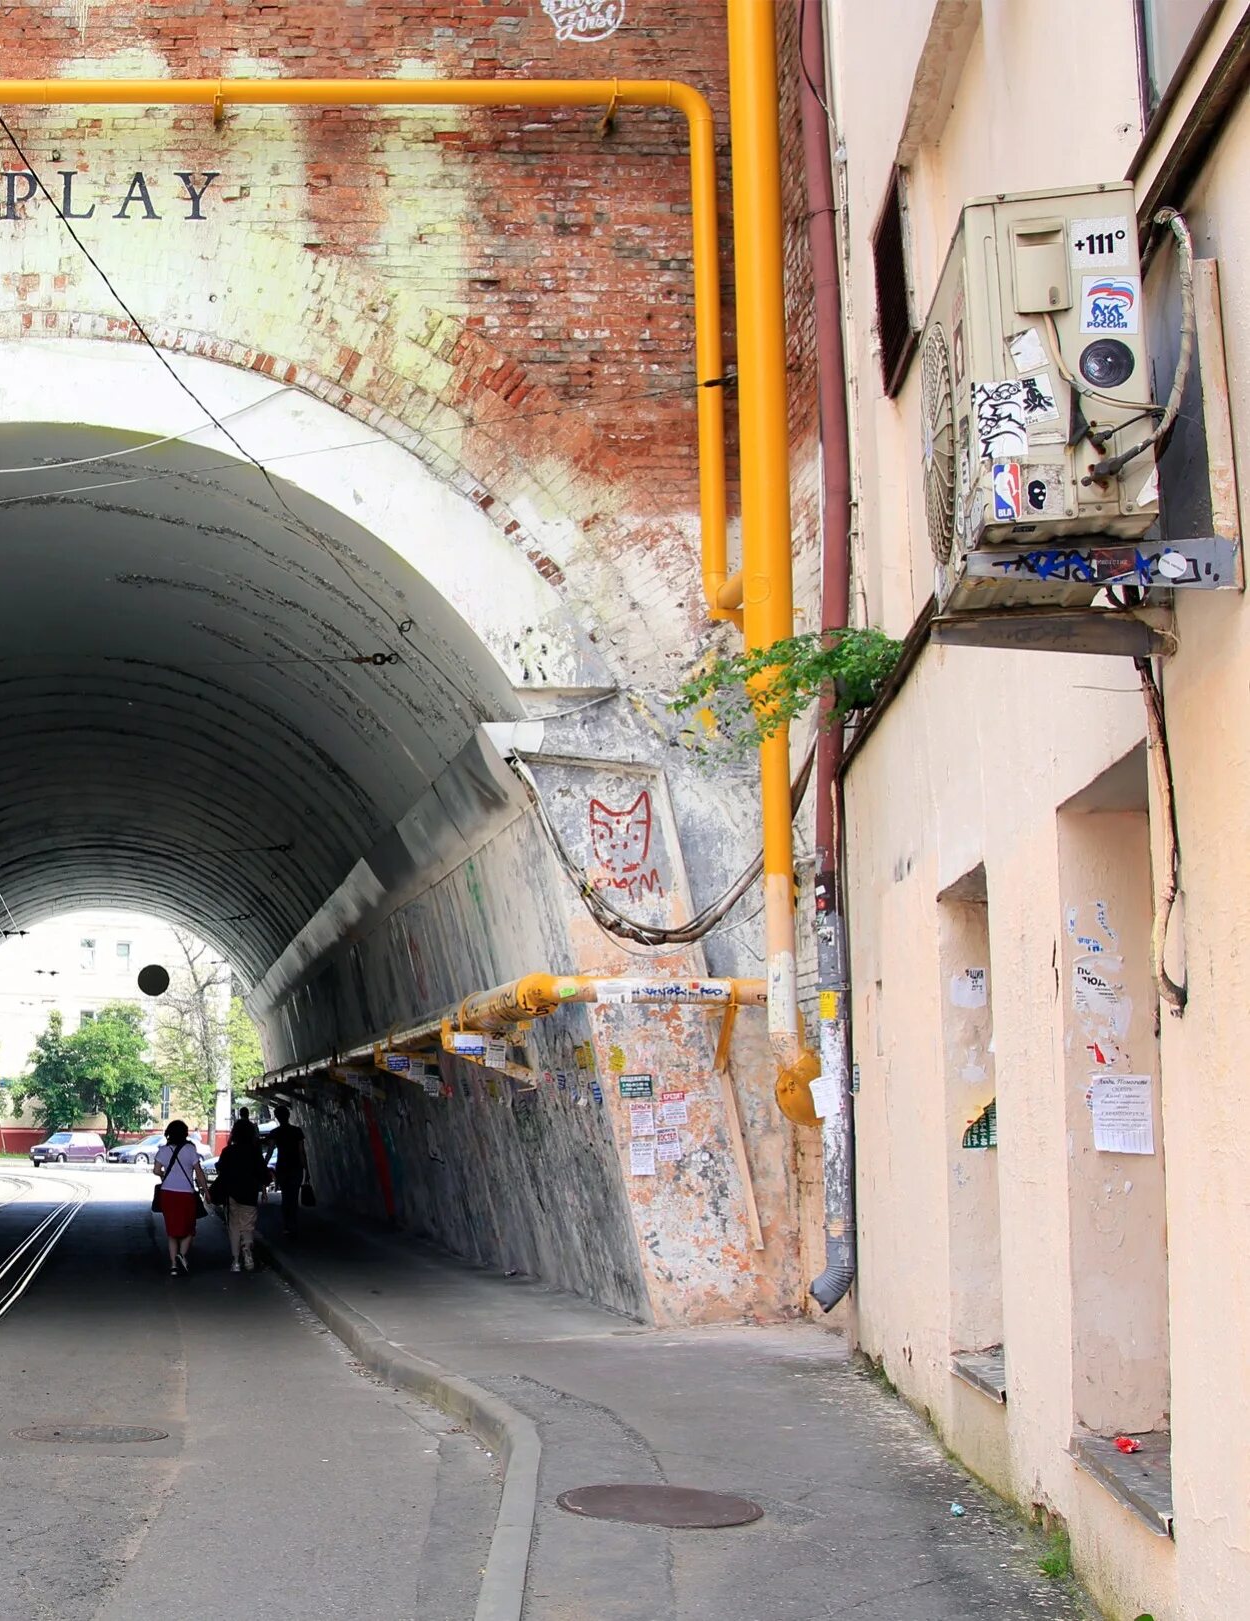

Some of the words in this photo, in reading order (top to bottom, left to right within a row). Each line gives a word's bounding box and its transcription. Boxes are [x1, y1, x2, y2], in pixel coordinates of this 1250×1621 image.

[1074, 229, 1126, 255] +111°
[1093, 312, 1125, 323] УЗОР
[1086, 321, 1128, 329] РОССИЯ
[997, 508, 1013, 518] BLA
